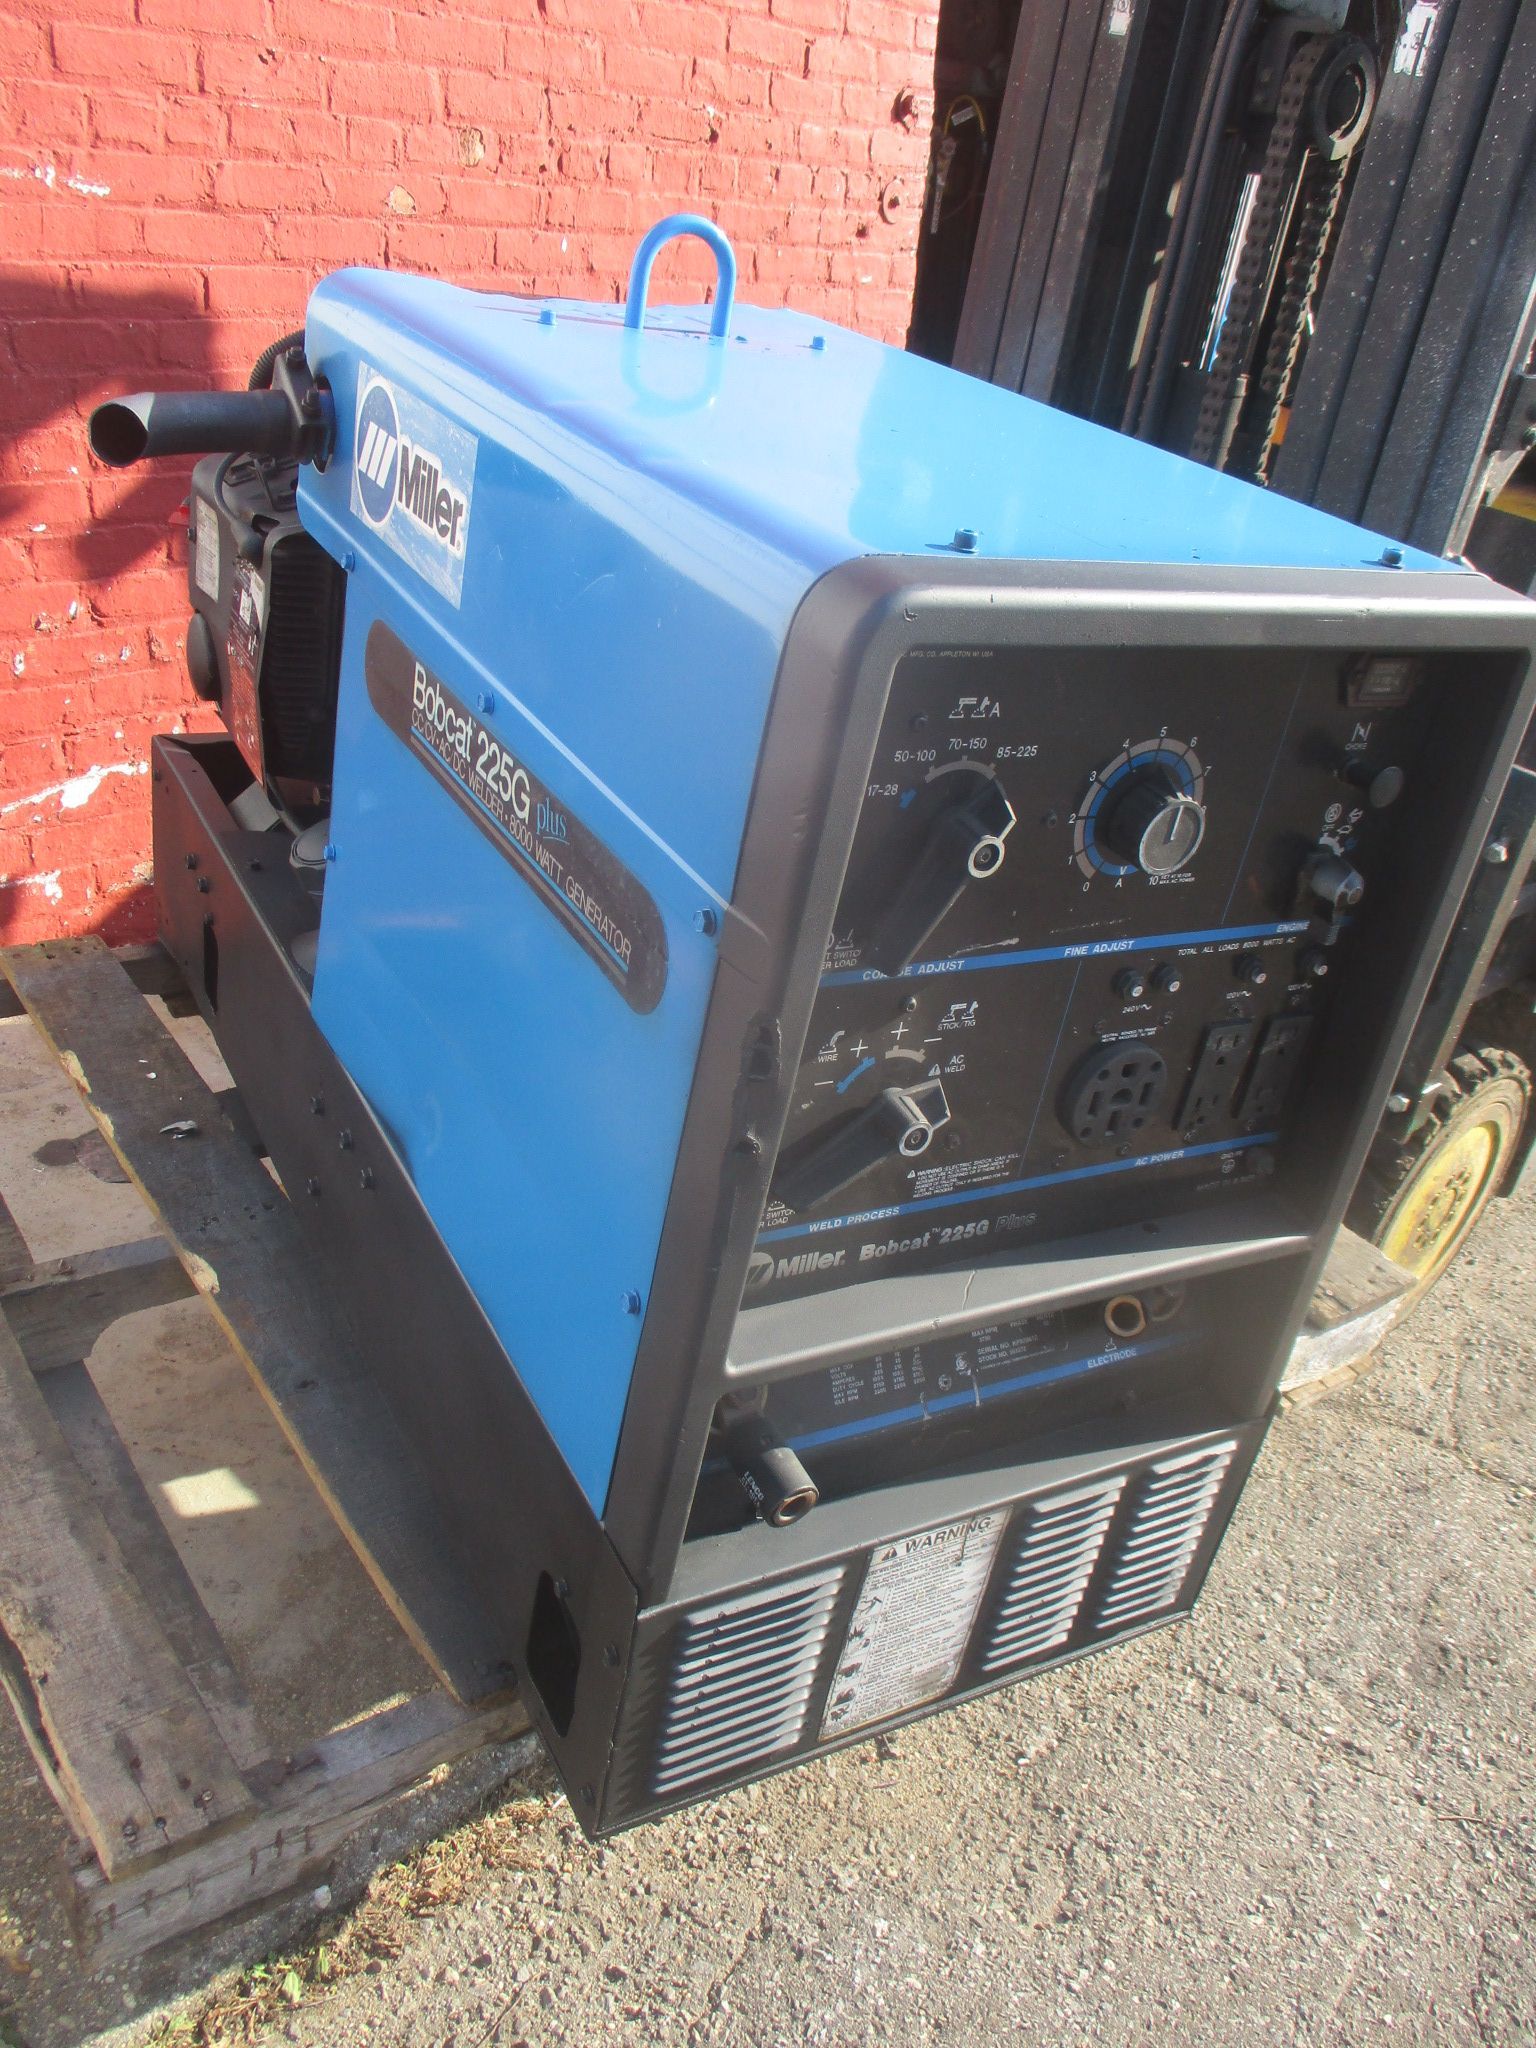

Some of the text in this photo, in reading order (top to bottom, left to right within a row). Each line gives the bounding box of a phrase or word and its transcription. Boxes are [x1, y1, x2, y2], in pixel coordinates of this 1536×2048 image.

[398, 444, 463, 547] Miller
[939, 650, 971, 658] APPLETON
[989, 702, 1000, 717] A
[1160, 727, 1168, 737] 5
[949, 738, 987, 750] 70-150
[1122, 738, 1130, 748] 4
[1190, 737, 1198, 748] 6
[894, 749, 936, 762] 50-100
[997, 745, 1038, 758] 85-225
[1089, 770, 1097, 782] 3
[1204, 765, 1212, 777] 7
[476, 731, 530, 824] 225G
[536, 798, 567, 839] plus
[868, 784, 899, 796] 17-28
[1069, 813, 1076, 824] 2
[1067, 855, 1073, 865] 1
[468, 769, 504, 821] WELDER
[509, 814, 532, 852] 8000
[535, 839, 563, 883] WATT
[565, 876, 632, 964] GENERATOR
[1114, 877, 1122, 888] A
[1149, 875, 1159, 886] 10
[1276, 921, 1310, 933] ENGINE
[1064, 940, 1135, 957] FINE ADJUST
[1178, 947, 1197, 956] TOTAL
[1201, 946, 1214, 954] ALL
[1218, 943, 1240, 952] LOADS
[834, 959, 857, 968] LOAD
[917, 960, 965, 974] ADJUST
[937, 1020, 976, 1031] STICK/TIG
[817, 1053, 838, 1063] WIRE
[950, 1054, 964, 1065] AC
[944, 1064, 966, 1074] WELD
[1135, 1150, 1184, 1167] AC POWER
[768, 1216, 789, 1227] LOAD
[809, 1206, 899, 1232] WELD PROCESS
[776, 1250, 846, 1279] Miller
[939, 1219, 990, 1245] 225G
[995, 1211, 1038, 1232] Plus
[977, 1344, 999, 1355] SERIAL
[978, 1353, 997, 1363] STOCK
[1087, 1348, 1138, 1369] ELECTRODE
[832, 1385, 846, 1393] DUTY
[848, 1380, 865, 1389] CYCLE
[905, 1517, 991, 1553] WARNING
